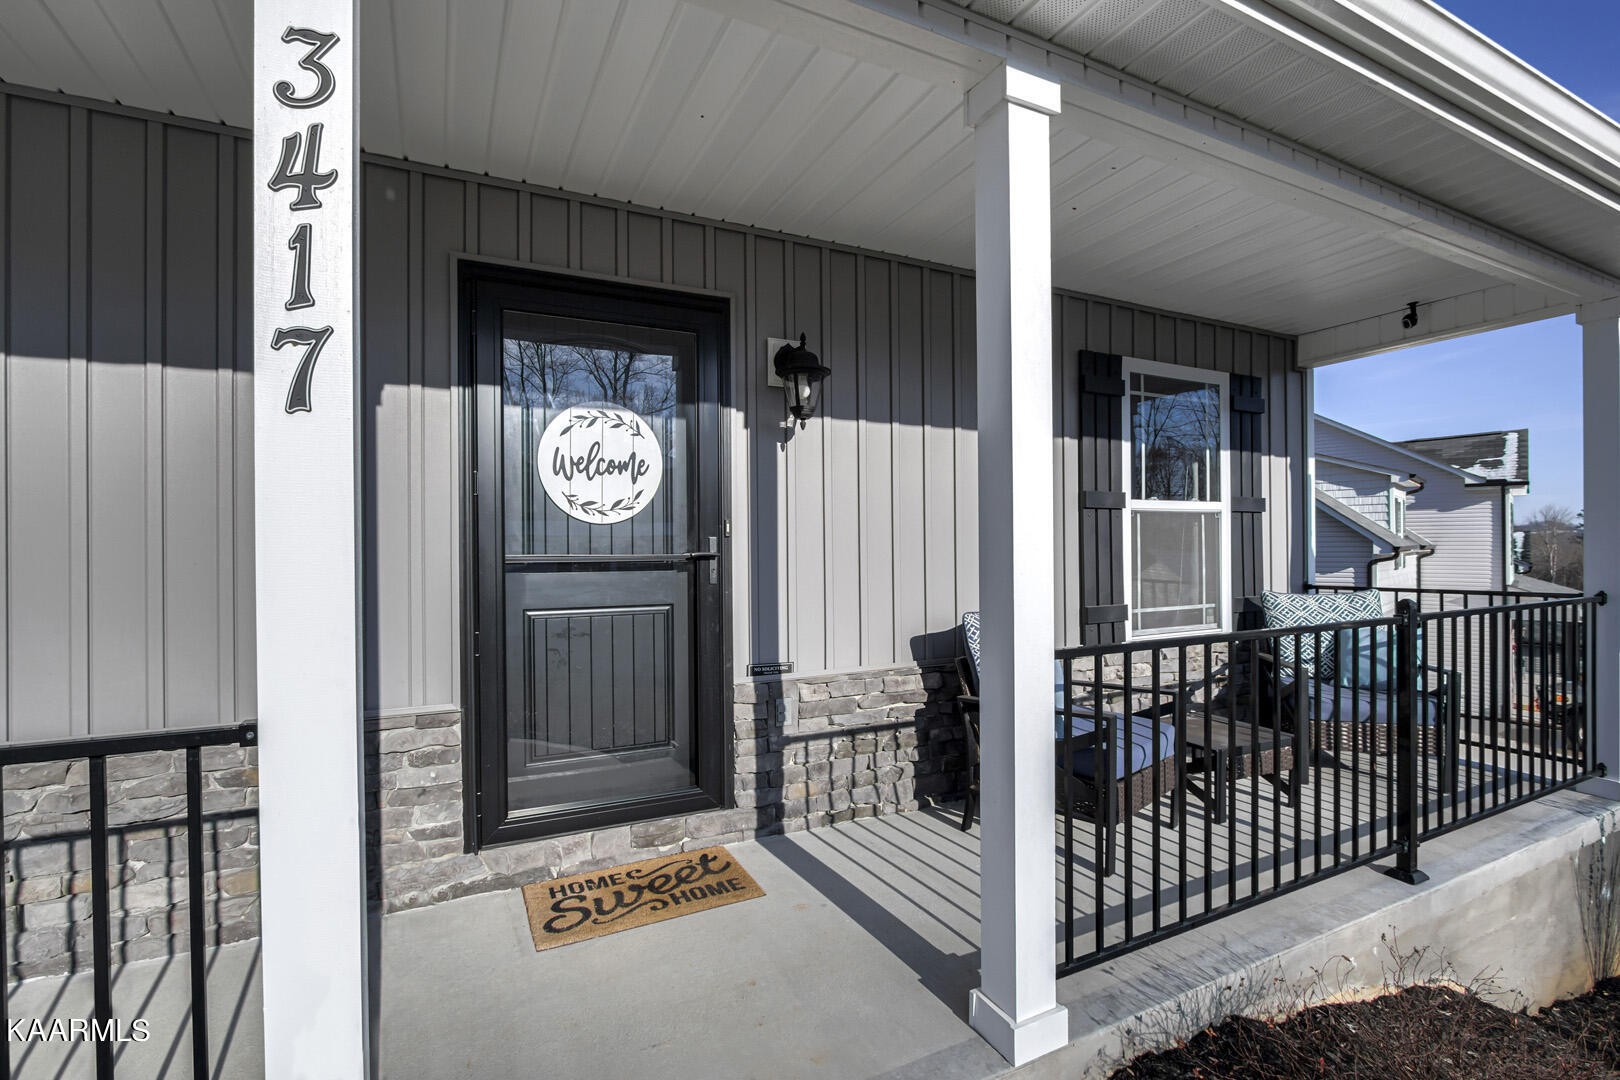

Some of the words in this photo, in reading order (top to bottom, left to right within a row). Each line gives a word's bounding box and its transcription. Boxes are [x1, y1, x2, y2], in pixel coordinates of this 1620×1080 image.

[268, 26, 340, 414] 3417
[553, 441, 649, 485] Welcome
[543, 853, 731, 933] Sweet
[549, 872, 625, 899] HOME
[668, 877, 746, 905] HOME
